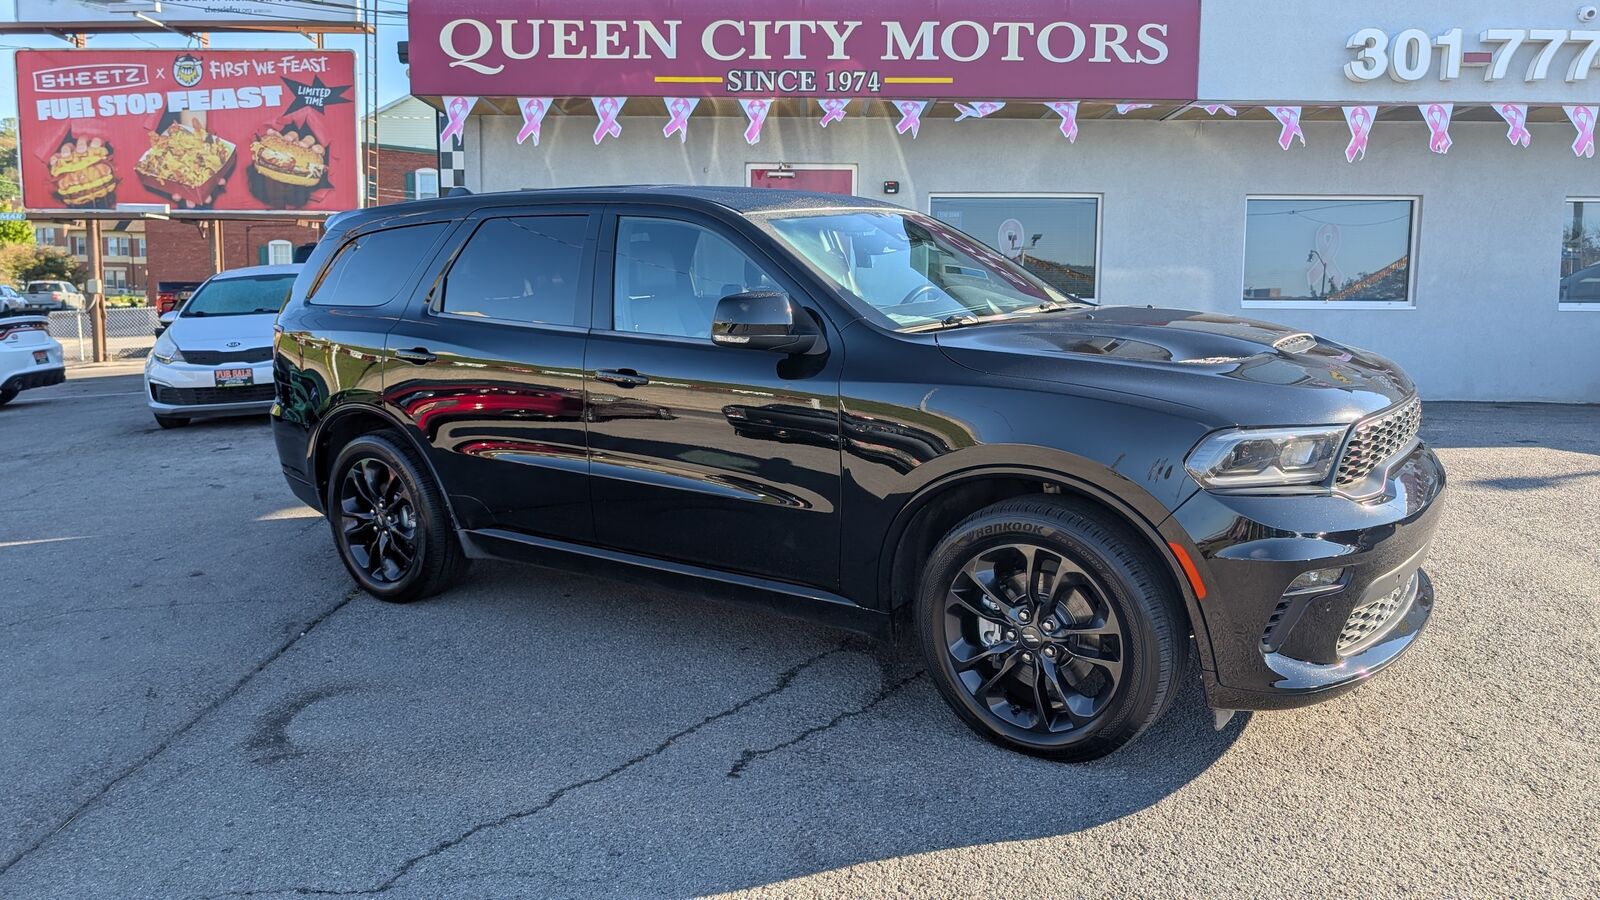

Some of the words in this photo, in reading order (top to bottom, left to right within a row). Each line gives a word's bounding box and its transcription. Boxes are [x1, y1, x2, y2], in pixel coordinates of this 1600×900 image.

[439, 18, 682, 75] QUEEN
[701, 19, 863, 61] CITY
[880, 20, 1169, 65] MOTORS
[41, 68, 140, 88] SHEETZ
[209, 59, 250, 80] FIRST
[252, 59, 277, 76] WE
[726, 70, 817, 92] SINCE
[825, 71, 882, 92] 1974
[297, 86, 332, 98] LIMITED
[304, 96, 324, 107] TIME
[36, 97, 96, 121] FUEL
[97, 92, 164, 117] STOP
[167, 85, 283, 113] FEAST
